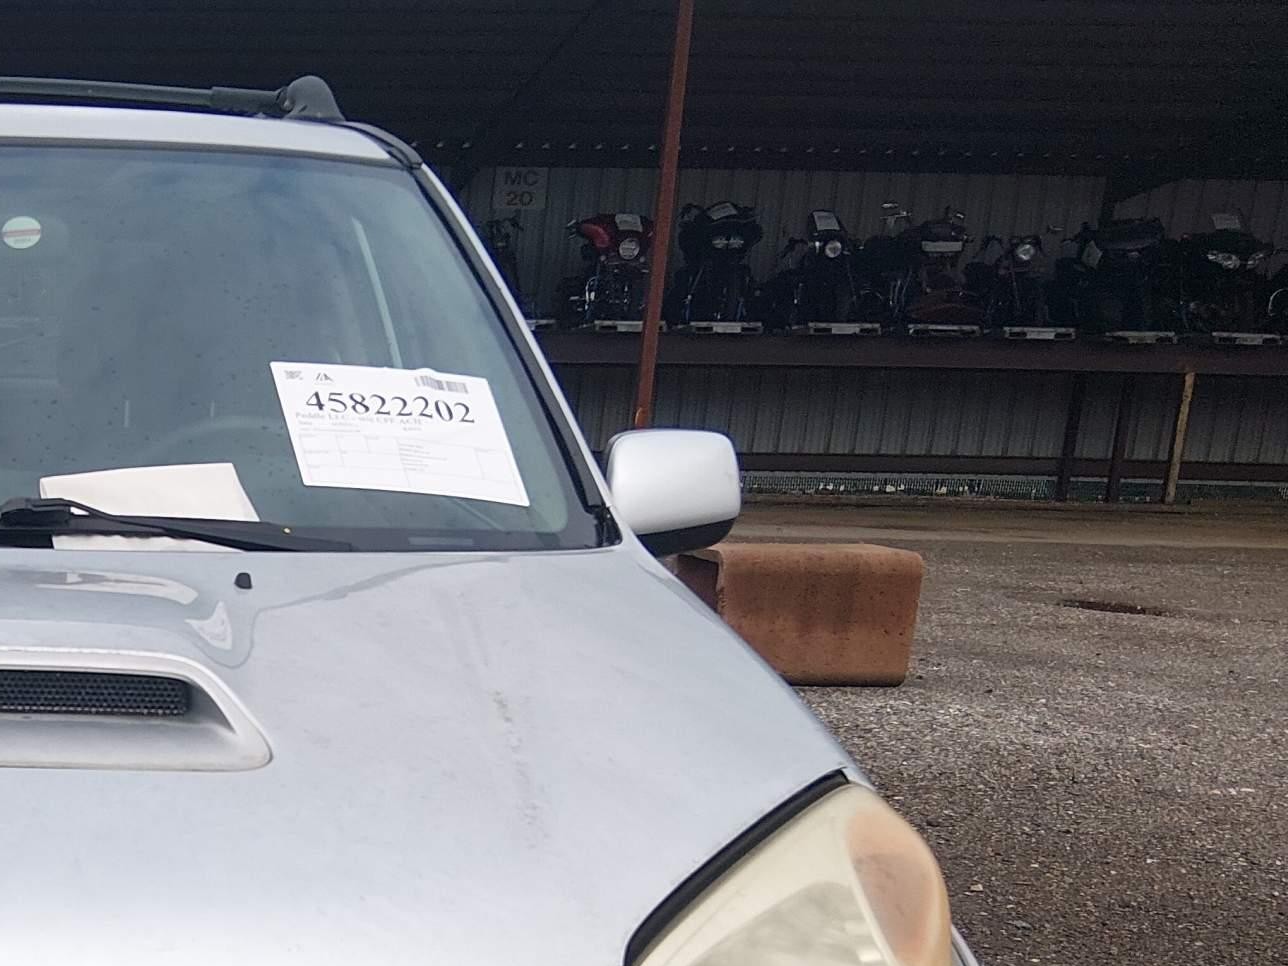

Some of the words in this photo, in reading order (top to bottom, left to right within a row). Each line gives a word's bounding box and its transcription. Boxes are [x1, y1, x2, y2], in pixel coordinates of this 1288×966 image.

[503, 170, 539, 186] MC
[503, 191, 533, 206] 20
[305, 391, 475, 423] 45822202
